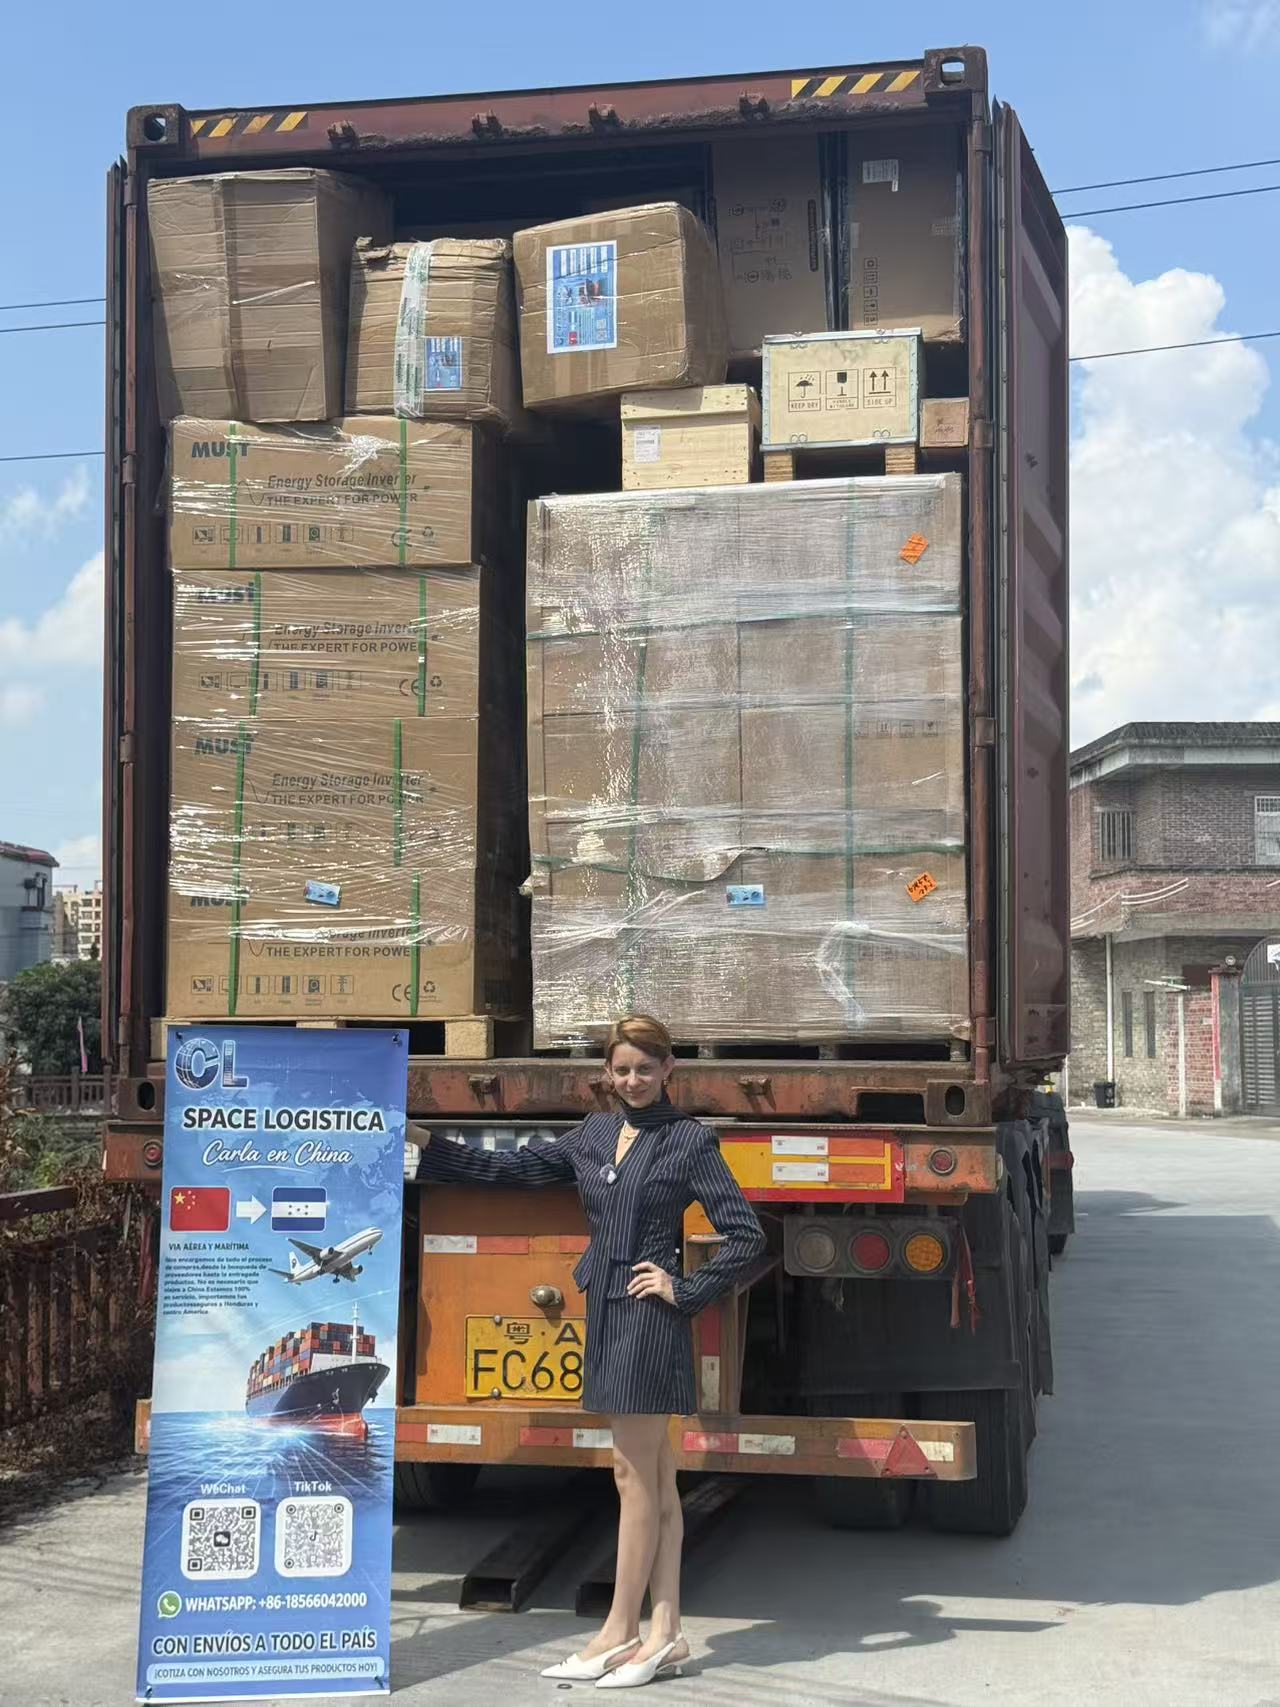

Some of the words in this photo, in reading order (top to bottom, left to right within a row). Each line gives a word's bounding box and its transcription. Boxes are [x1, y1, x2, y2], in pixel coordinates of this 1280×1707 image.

[192, 441, 248, 458] MUST
[267, 475, 312, 490] Energy
[315, 474, 364, 489] Storage
[367, 473, 417, 485] Inverer
[266, 496, 289, 506] THE
[294, 495, 340, 505] EXPERT
[344, 494, 369, 504] FOR
[373, 493, 418, 503] POWR
[275, 623, 321, 638] Energy
[323, 621, 372, 637] Storage
[375, 621, 423, 635] Inverte
[273, 643, 297, 652] THE
[301, 643, 350, 653] EXPERT
[352, 642, 377, 652] FOR
[380, 642, 419, 652] POWE
[194, 736, 254, 754] MUST
[272, 774, 317, 790] Energy
[320, 773, 369, 789] Storage
[373, 773, 424, 787] Invrter
[272, 794, 295, 804] THE
[299, 794, 347, 804] EXPERT
[350, 794, 375, 804] FOR
[379, 794, 424, 804] POER
[368, 927, 415, 939] Inverte
[267, 947, 289, 957] THE
[294, 947, 344, 957] EXPERT
[345, 947, 370, 957] FOR
[373, 946, 412, 957] POWE
[175, 1038, 249, 1090] CL
[183, 1108, 257, 1130] SPACE
[264, 1109, 384, 1132] LOGISTICA
[202, 1140, 260, 1166] Carla
[267, 1148, 291, 1163] en
[294, 1140, 353, 1167] China
[169, 1243, 181, 1251] VIA
[208, 1243, 214, 1251] Y
[200, 1483, 247, 1495] WeChat
[294, 1481, 332, 1492] TikTok
[185, 1594, 257, 1612] WHATSAPP:
[258, 1592, 368, 1610] +86-18566042000
[153, 1635, 187, 1655] CON
[193, 1630, 251, 1654] ENVÍOS
[256, 1636, 267, 1652] A
[271, 1634, 316, 1651] TODO
[320, 1632, 337, 1649] EL
[342, 1626, 376, 1649] PAÍS
[187, 1663, 205, 1677] CON
[206, 1662, 250, 1676] NOSOTROS
[251, 1662, 257, 1675] Y
[258, 1661, 294, 1675] ASEGURA
[294, 1660, 309, 1674] TUS
[311, 1659, 357, 1674] PRODUCTOS
